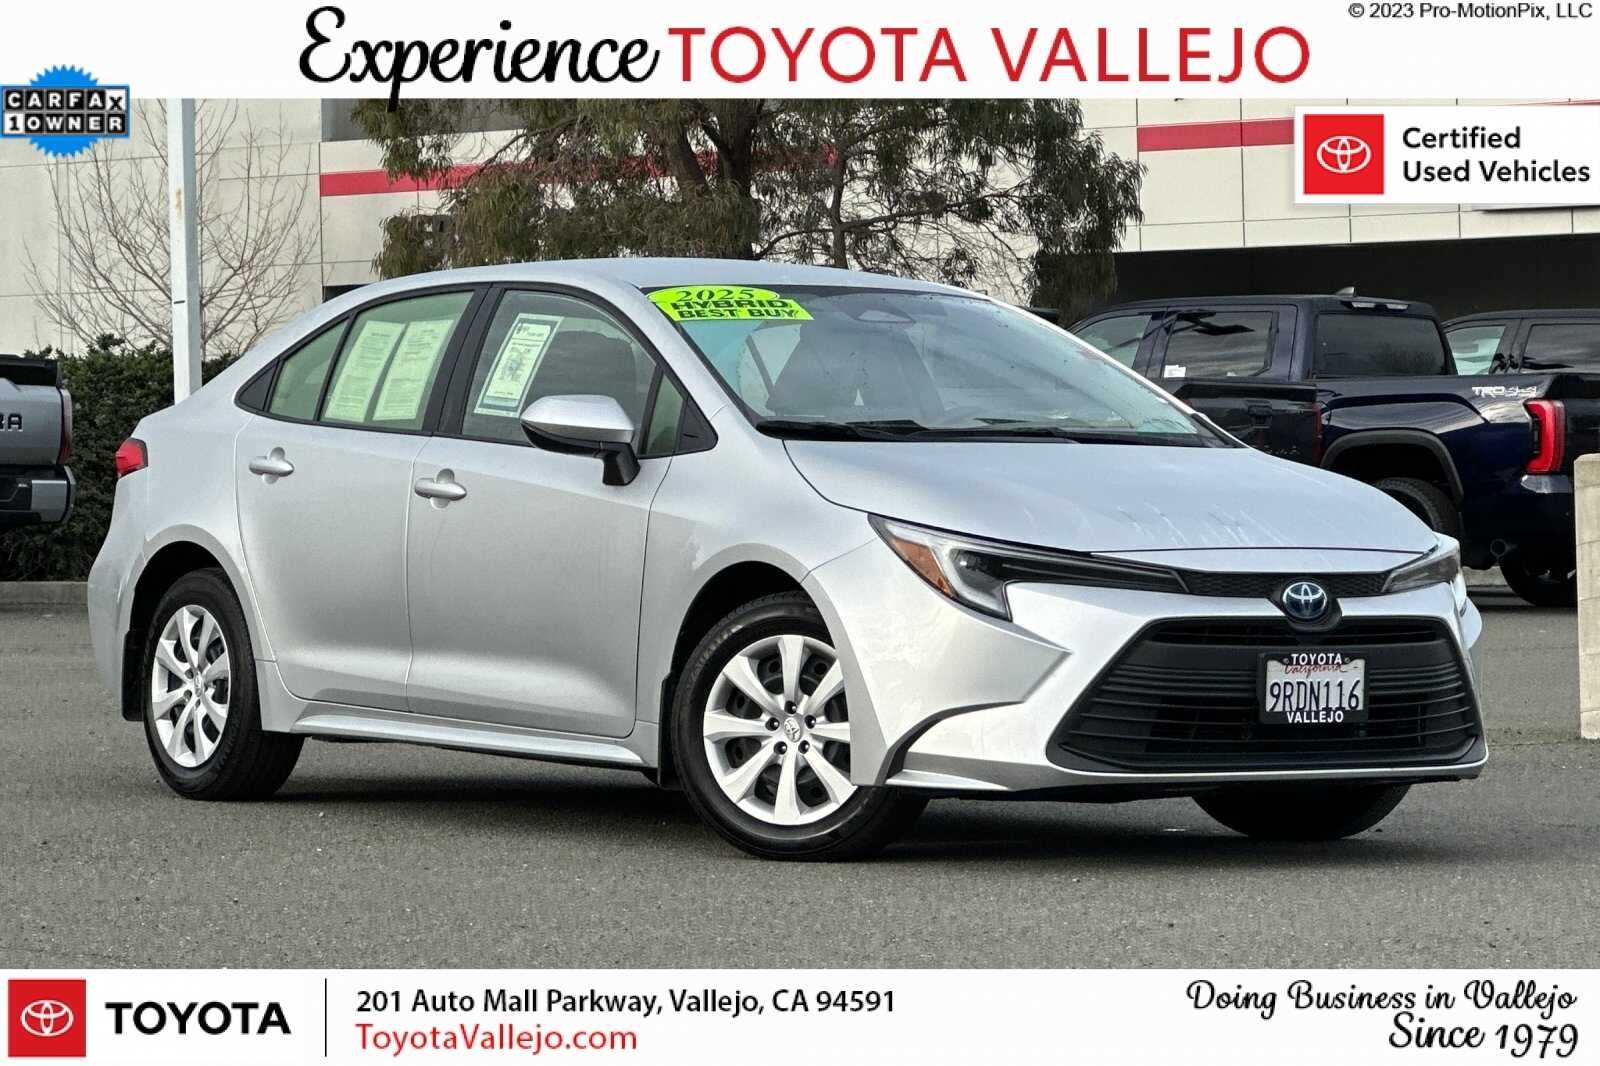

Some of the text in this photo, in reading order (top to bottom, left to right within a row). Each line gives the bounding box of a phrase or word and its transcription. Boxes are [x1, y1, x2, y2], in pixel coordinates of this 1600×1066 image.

[676, 288, 755, 302] 2025
[671, 299, 789, 310] HYBRID
[680, 308, 800, 319] BEST BUY
[1291, 653, 1343, 666] TOYOTA
[1269, 679, 1361, 712] 9RDN116
[1286, 710, 1345, 724] VALLEJO
